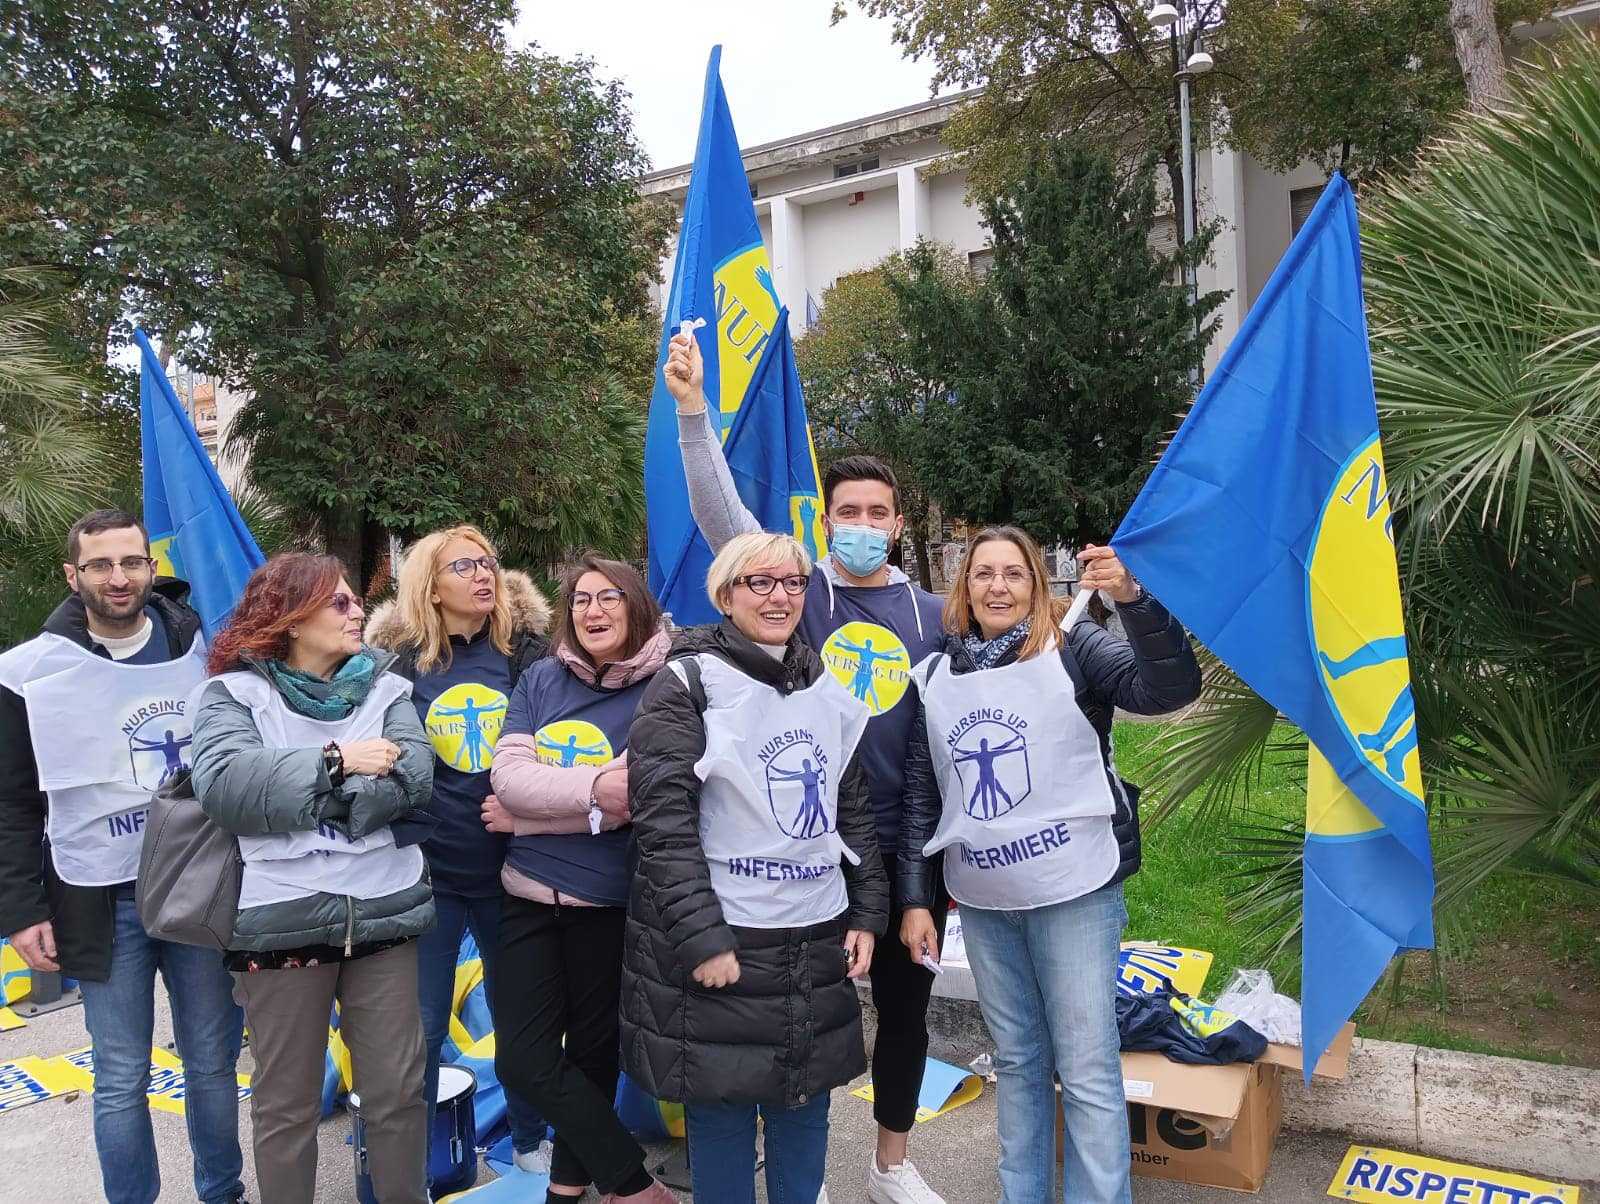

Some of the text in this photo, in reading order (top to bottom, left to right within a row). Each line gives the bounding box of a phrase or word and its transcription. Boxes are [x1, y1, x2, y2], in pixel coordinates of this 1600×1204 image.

[947, 708, 1028, 746] NURSING UP
[757, 729, 828, 765] NURSIN UP
[108, 810, 150, 837] INF
